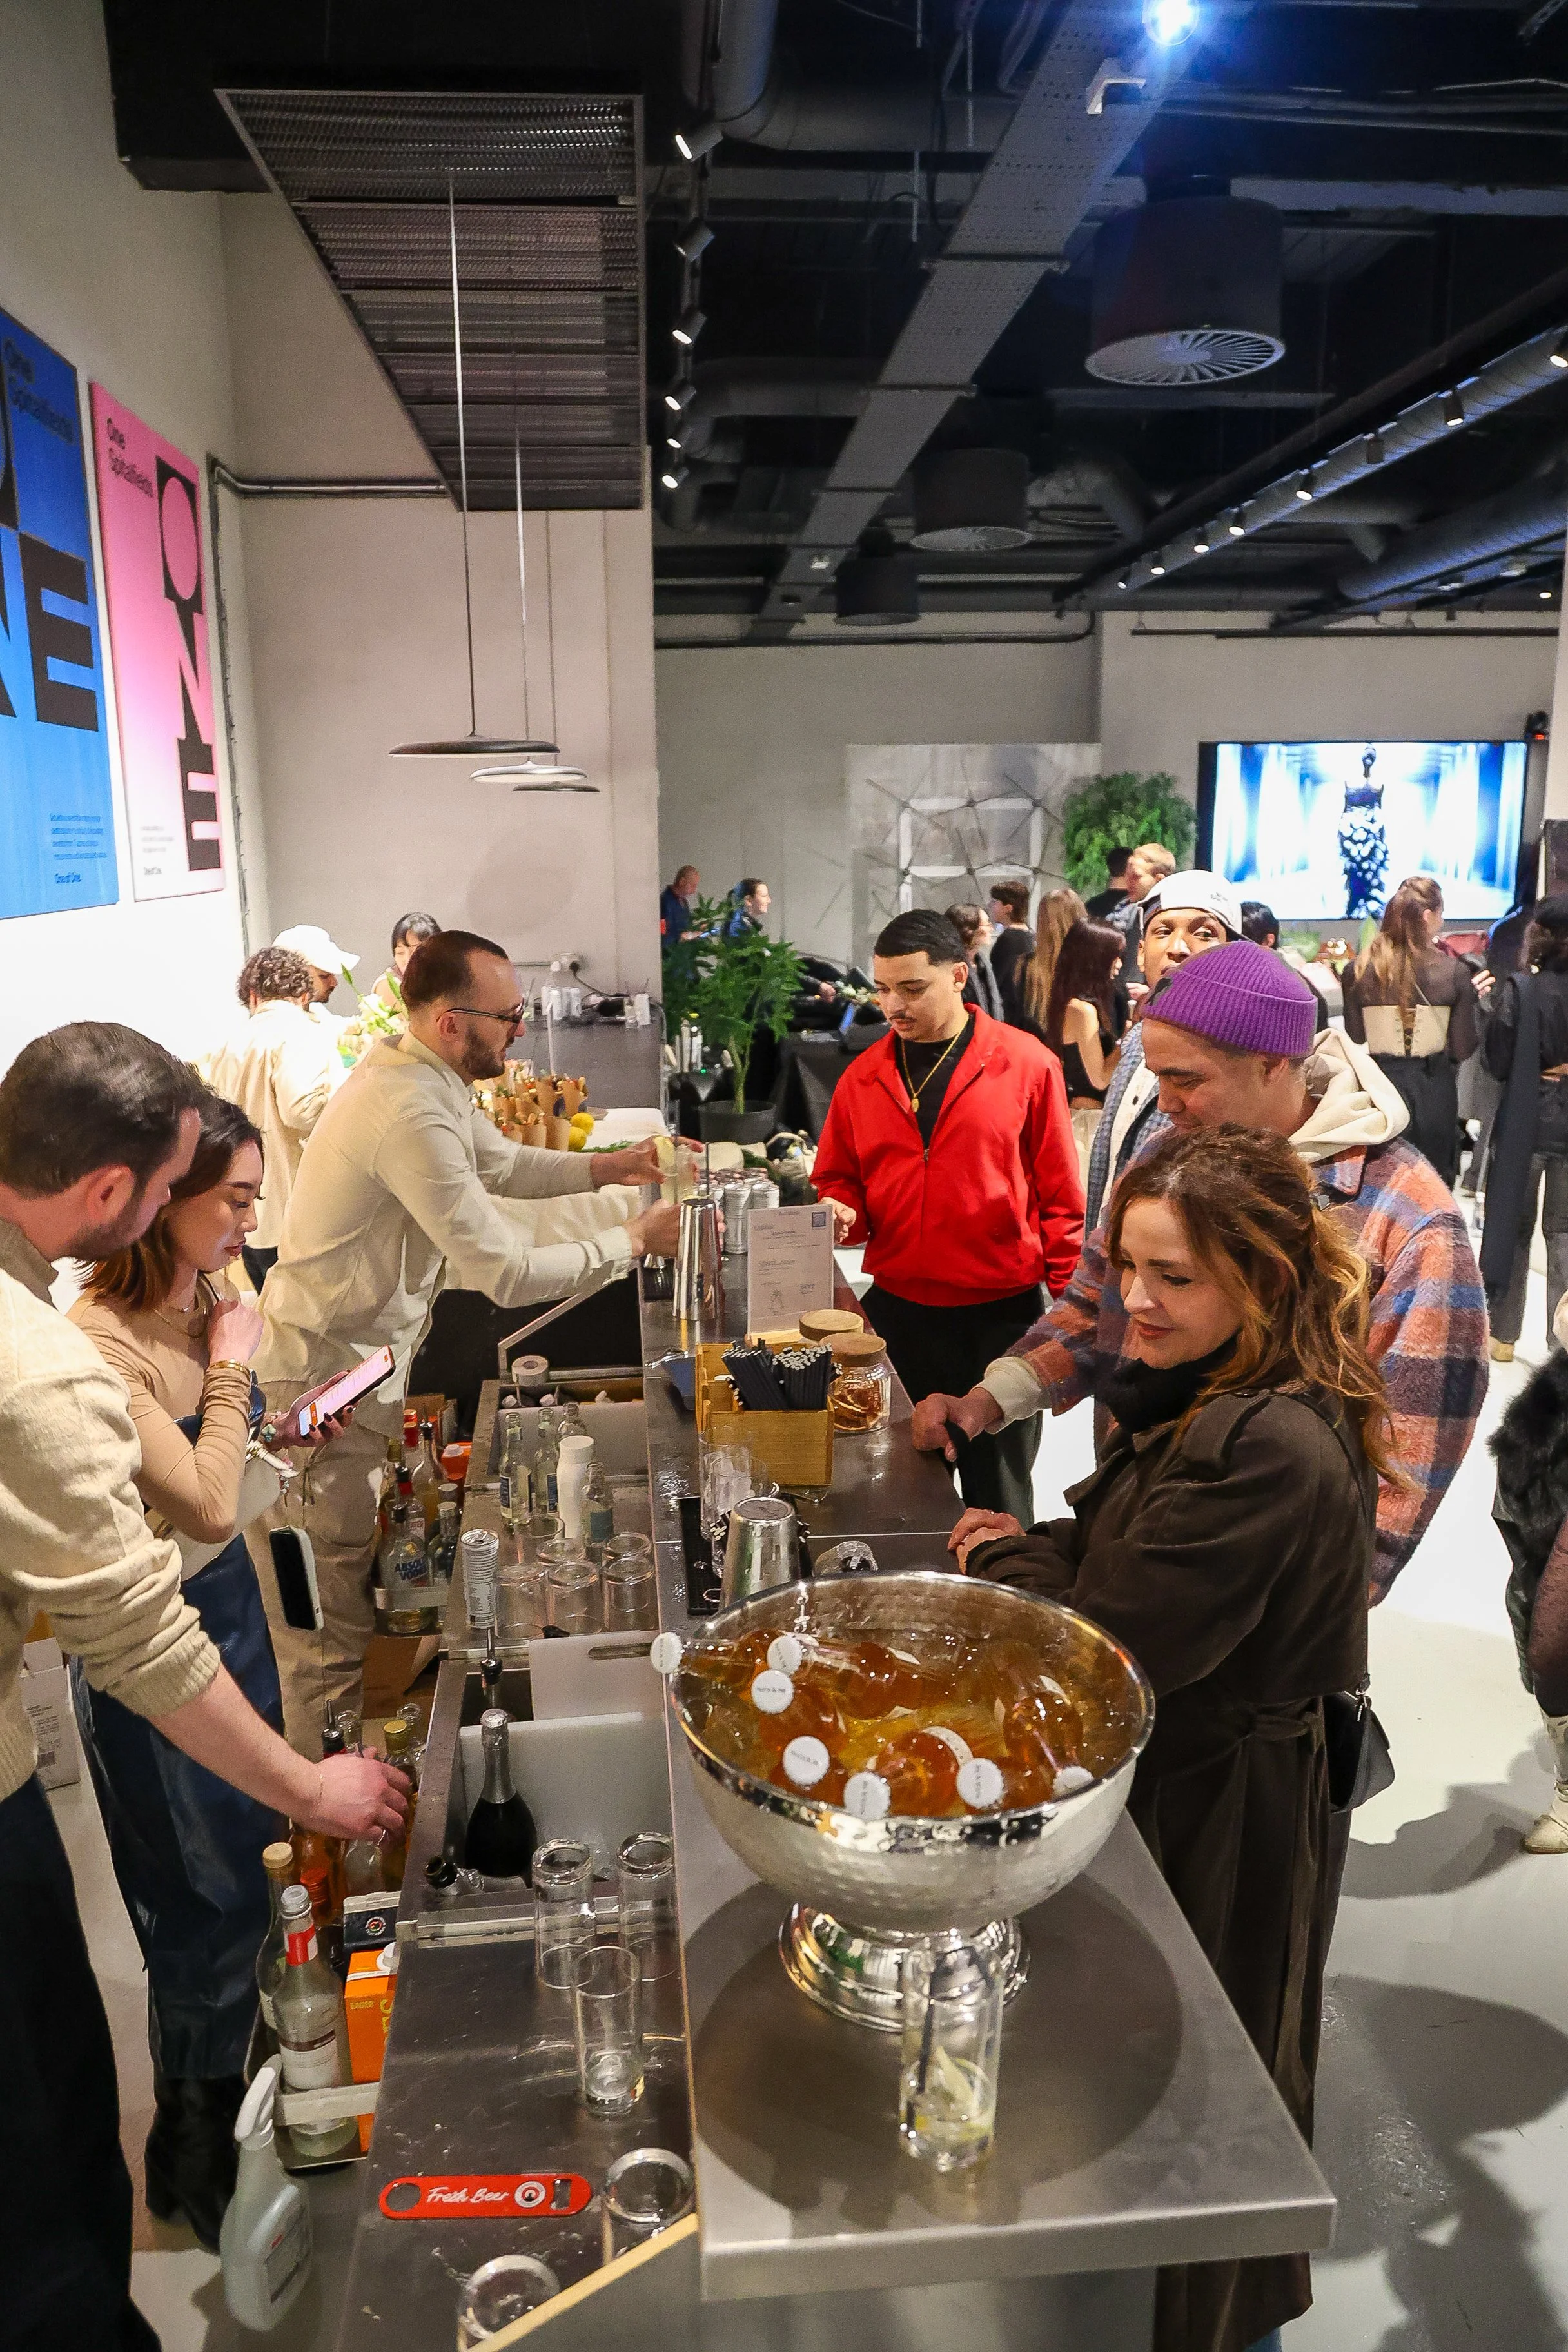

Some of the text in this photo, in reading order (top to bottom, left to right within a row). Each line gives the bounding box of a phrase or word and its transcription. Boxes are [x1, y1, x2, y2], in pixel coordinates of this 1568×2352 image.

[0, 530, 99, 732] E
[427, 2186, 509, 2203] Fresh Beer
